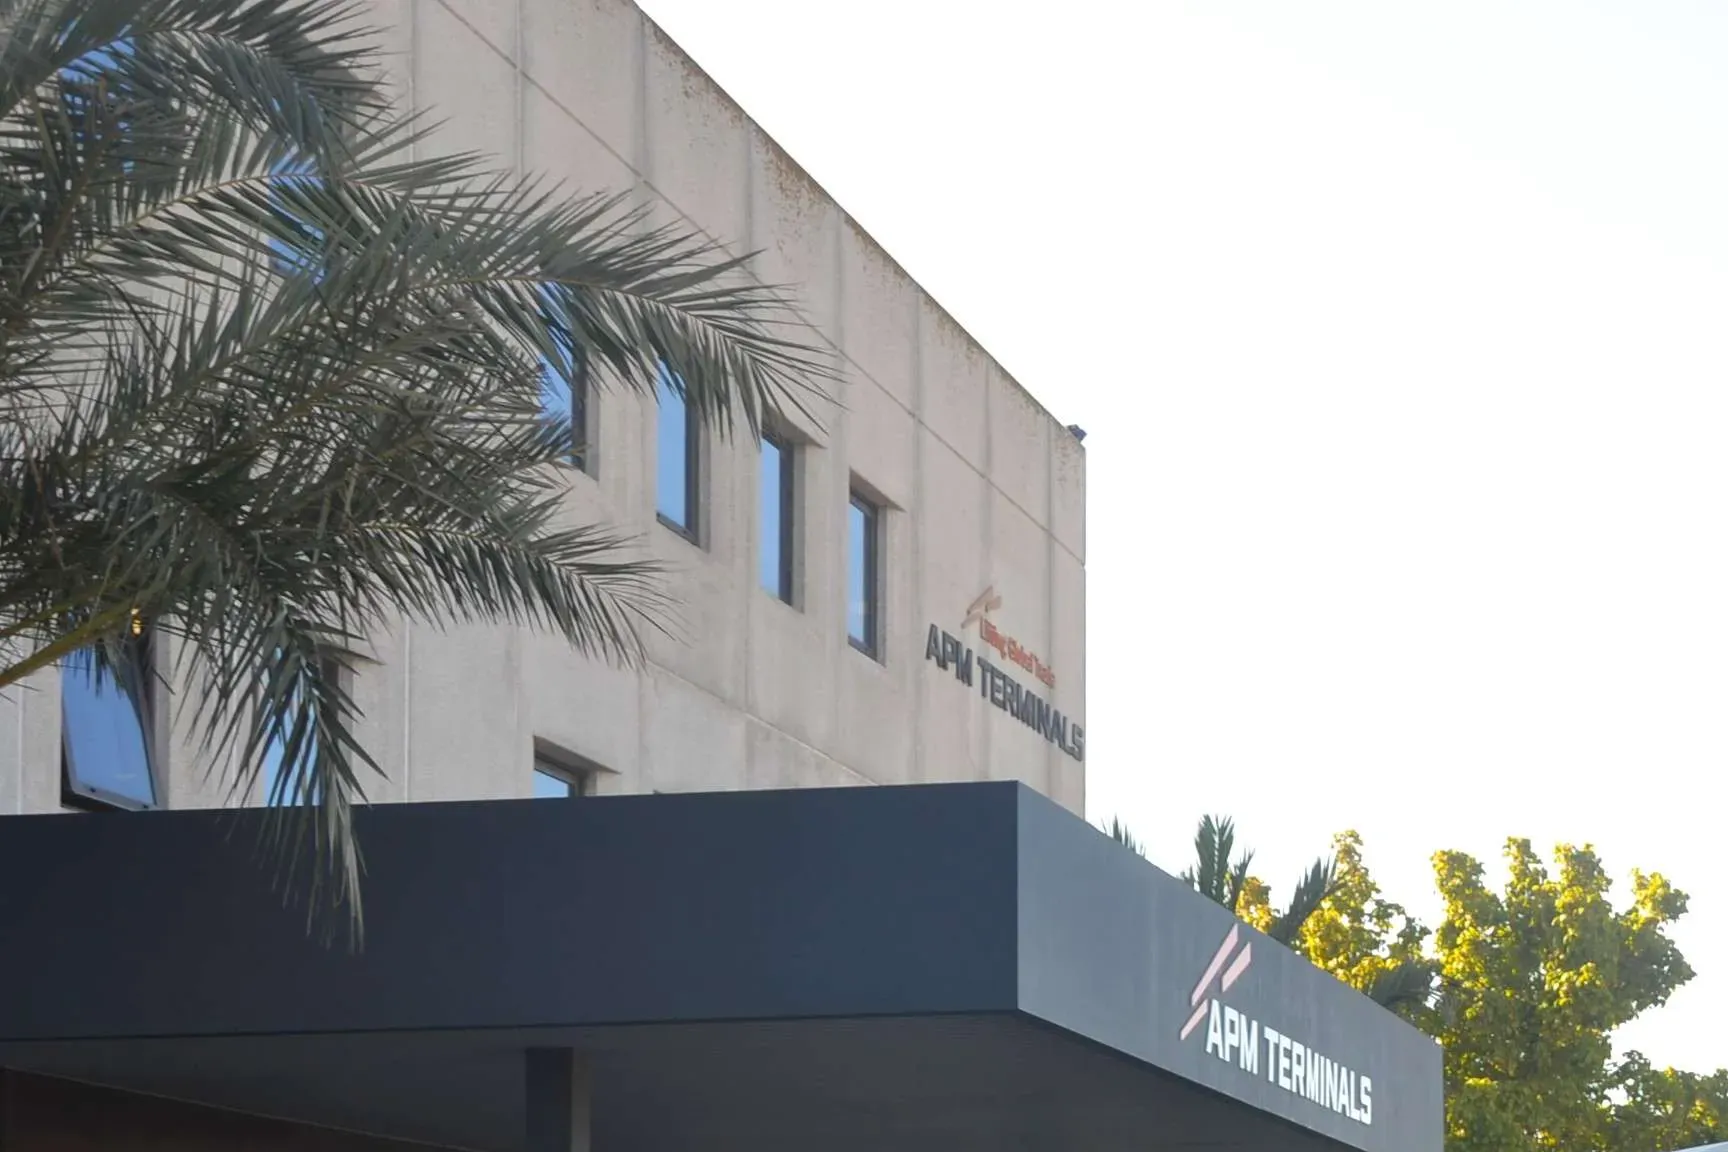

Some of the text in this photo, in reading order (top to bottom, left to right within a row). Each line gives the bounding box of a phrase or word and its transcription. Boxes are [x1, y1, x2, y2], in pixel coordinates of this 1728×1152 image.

[925, 623, 1084, 762] APM TERMINALS
[1206, 999, 1372, 1125] APM TERMINALS
